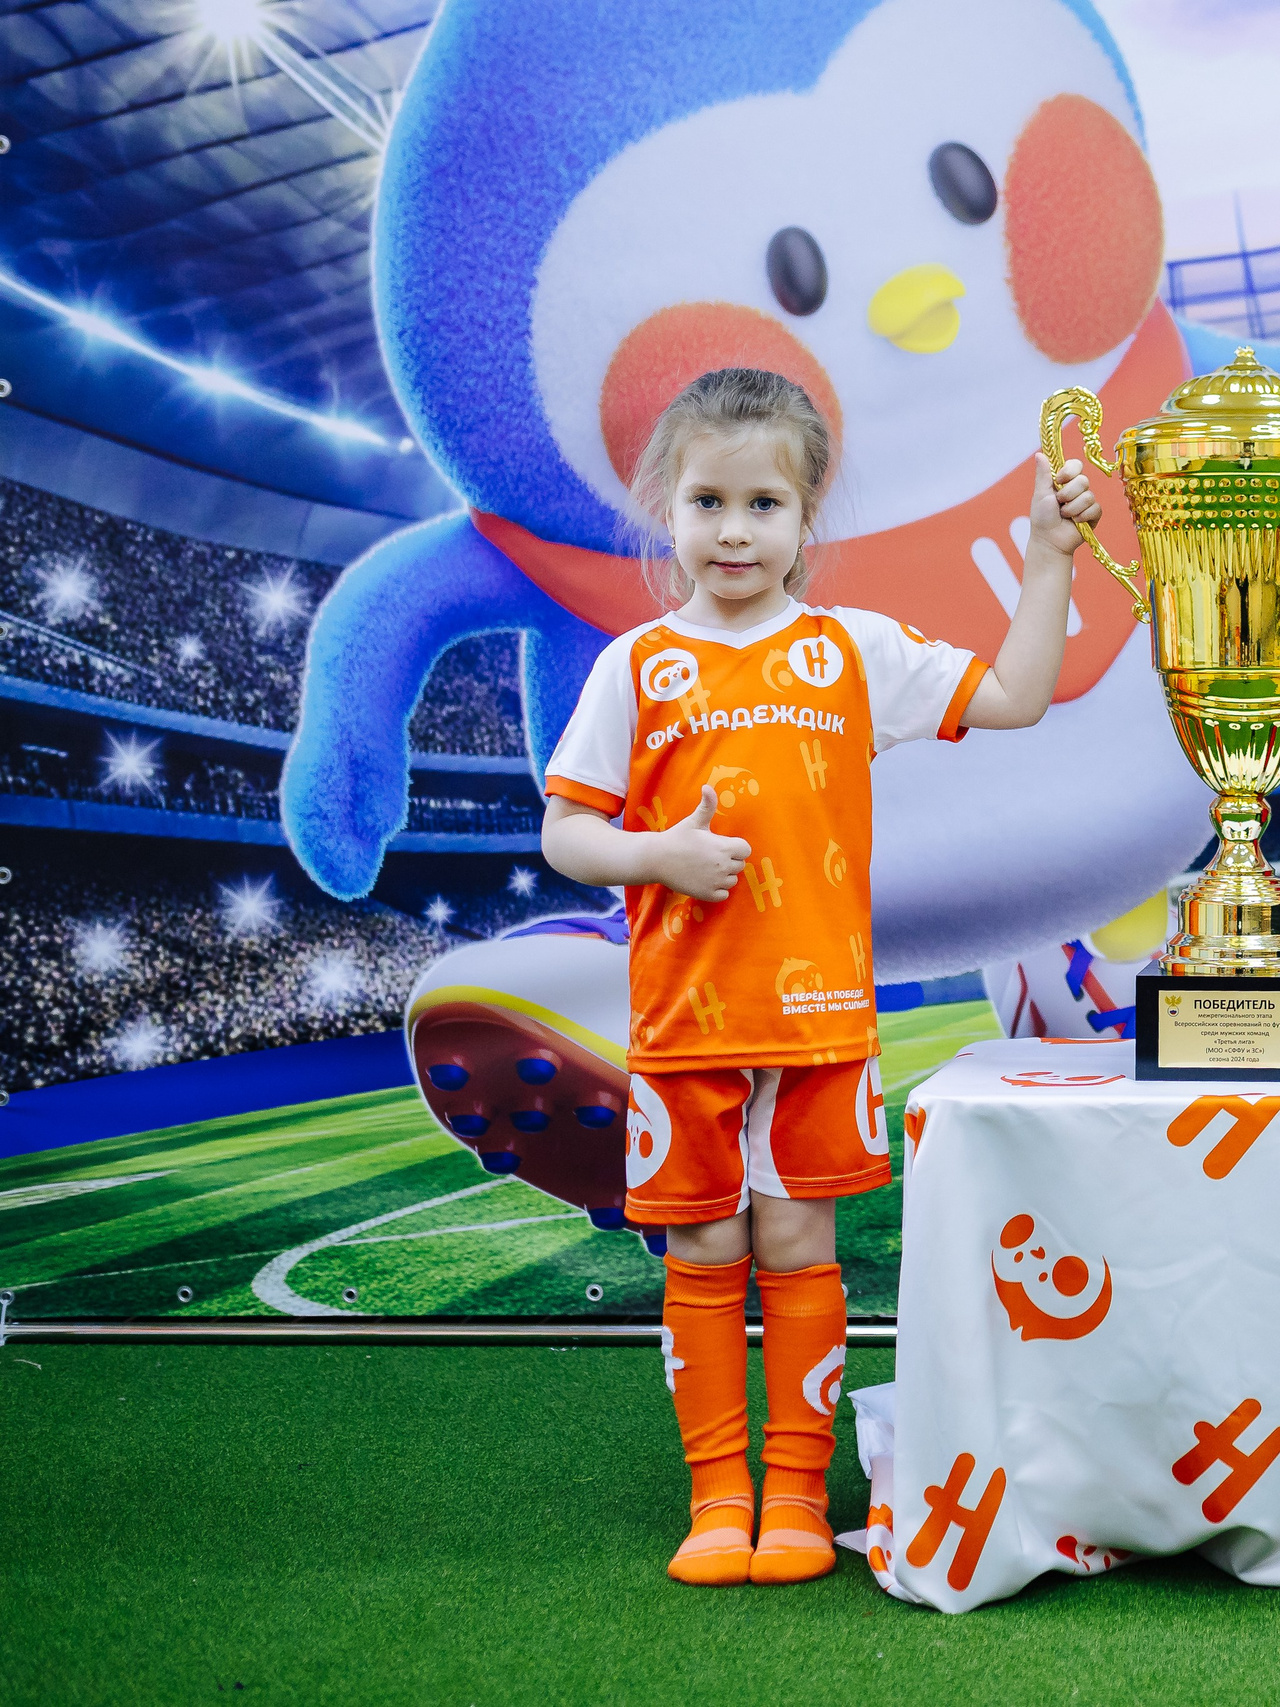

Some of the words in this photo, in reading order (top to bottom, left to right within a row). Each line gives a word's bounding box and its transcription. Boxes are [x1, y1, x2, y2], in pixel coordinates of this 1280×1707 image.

[645, 720, 685, 750] ФК
[688, 704, 846, 735] НАДЕЖДИК
[781, 990, 826, 1003] ВПЕРЁД
[826, 991, 833, 1000] К
[782, 1003, 827, 1015] ВМЕСТЕ
[827, 1002, 842, 1012] МЫ
[1194, 999, 1276, 1011] ПОБЕДИТЕЛЬ
